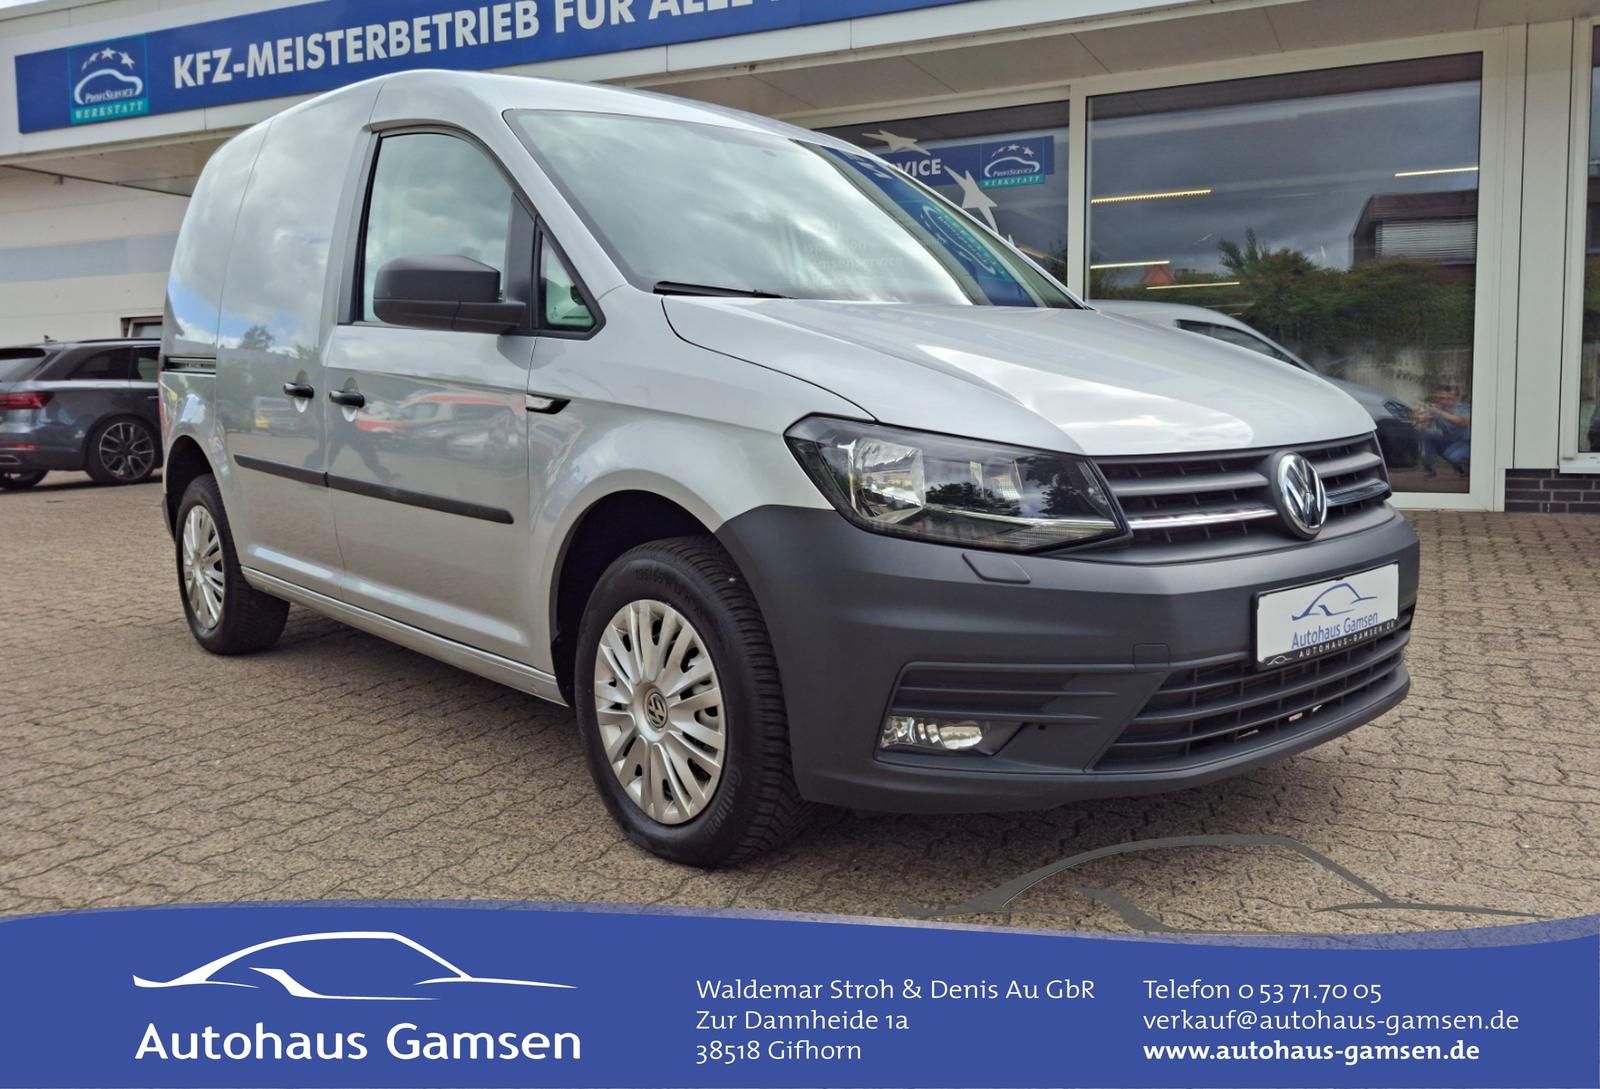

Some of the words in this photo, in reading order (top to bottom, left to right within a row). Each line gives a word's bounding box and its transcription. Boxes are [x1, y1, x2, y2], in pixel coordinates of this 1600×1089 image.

[174, 1, 539, 89] KFZ-MEISTERBETRIEB
[75, 100, 144, 120] WERKSTATT
[890, 158, 942, 177] VICE
[984, 175, 1040, 187] WERKSTATT
[1290, 624, 1341, 650] Autohaus
[1343, 611, 1379, 634] Gamsen
[1298, 620, 1395, 658] AUTOHAUS-GAMSEN.DE
